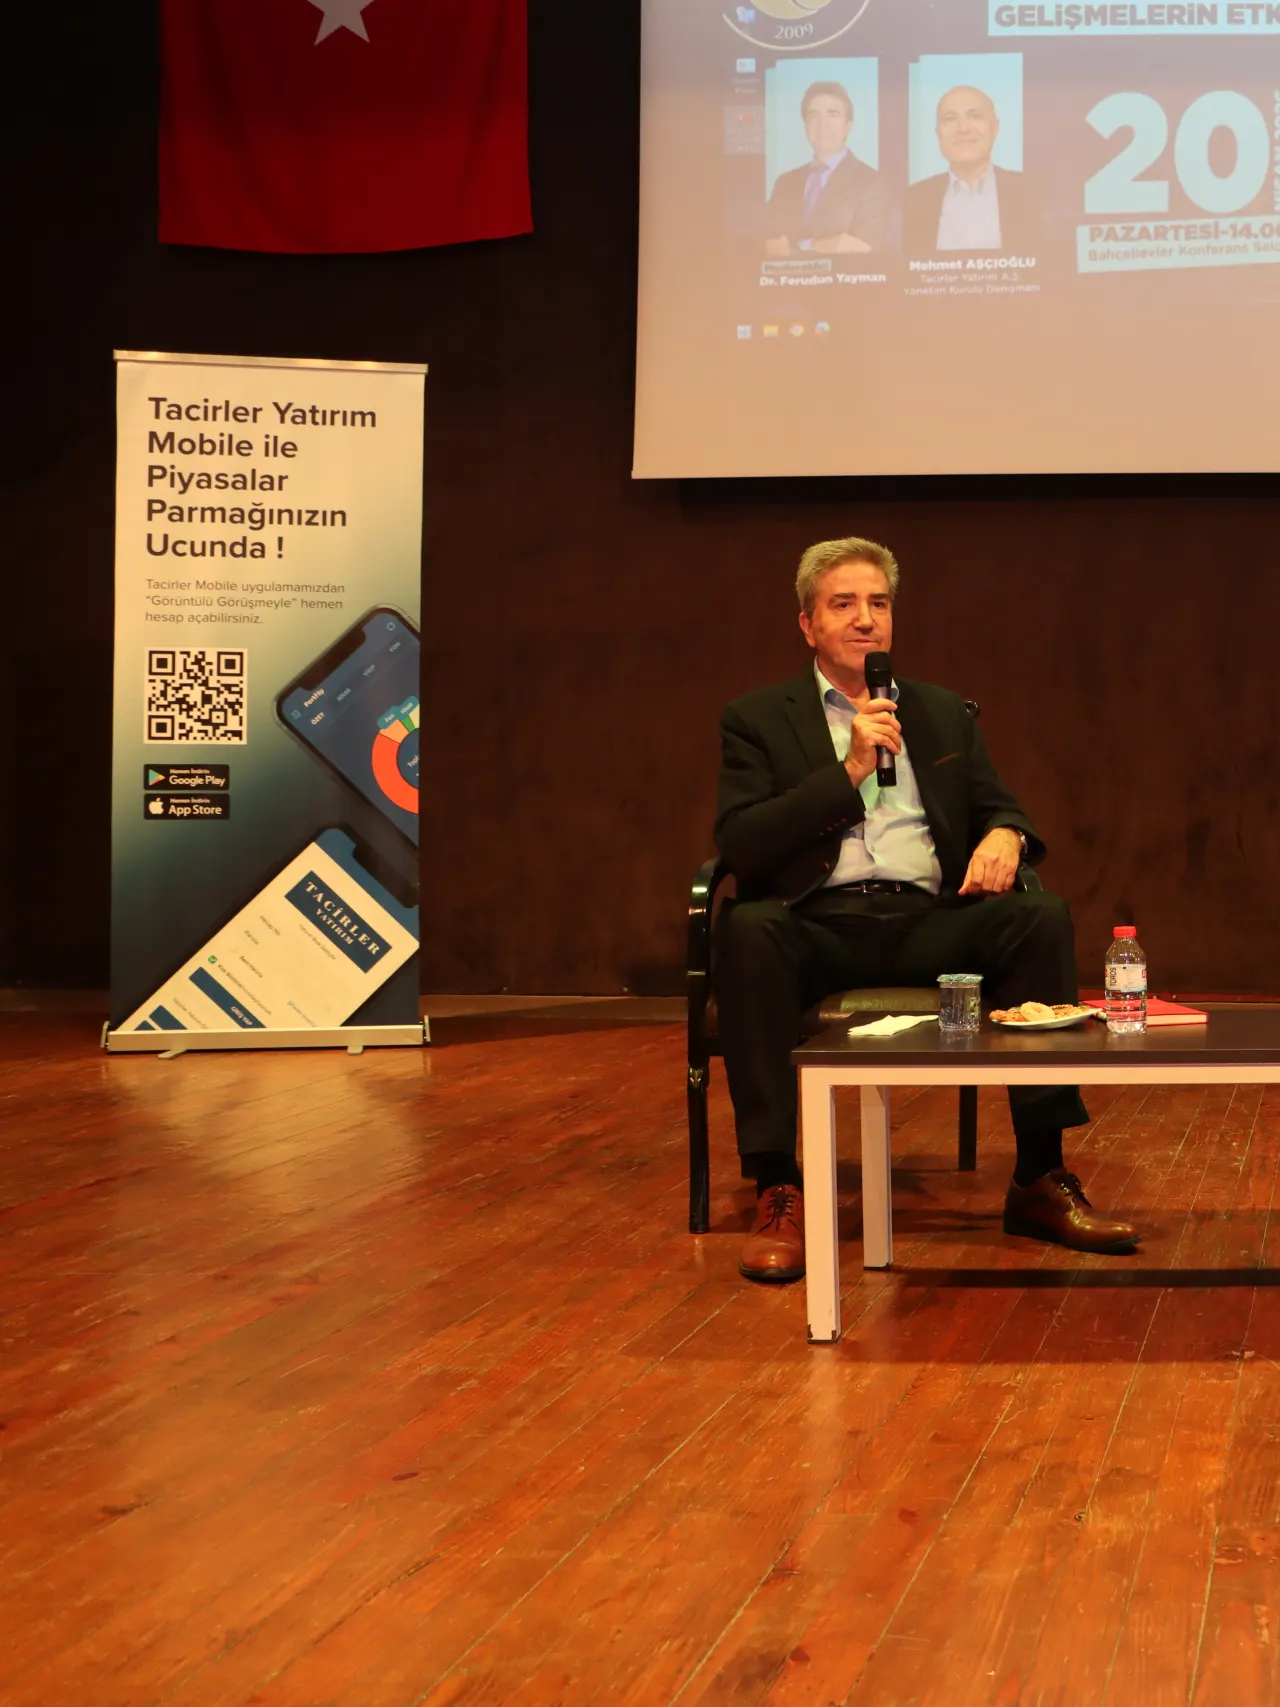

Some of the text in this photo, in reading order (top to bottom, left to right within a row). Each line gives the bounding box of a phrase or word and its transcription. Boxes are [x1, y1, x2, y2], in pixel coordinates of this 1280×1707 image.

[995, 3, 1218, 30] GELİŞMELERİN
[774, 23, 814, 39] 2009
[1084, 90, 1271, 214] 20
[909, 255, 1036, 271] Mehmet AŞÇIOĞLU
[1088, 245, 1174, 263] Bahçelievler
[1179, 243, 1249, 259] Konferans
[759, 273, 886, 286] Dr. Ferudun Yayman
[920, 273, 957, 283] Tacirler
[148, 396, 377, 428] Tacirler Yatırım
[148, 430, 299, 459] Mobile ile
[147, 464, 289, 495] Piyasalar
[147, 498, 348, 531] Parmağınızın
[146, 533, 285, 559] Ucunda !
[145, 578, 346, 595] Tacirler Mobile uygulamamızdan
[300, 598, 343, 610] hemen
[145, 611, 264, 626] hesap açabilirsiniz.
[169, 775, 226, 787] Google Play
[168, 804, 223, 817] App Store
[304, 881, 382, 955] TACİRLER
[315, 907, 355, 945] YATIRIM
